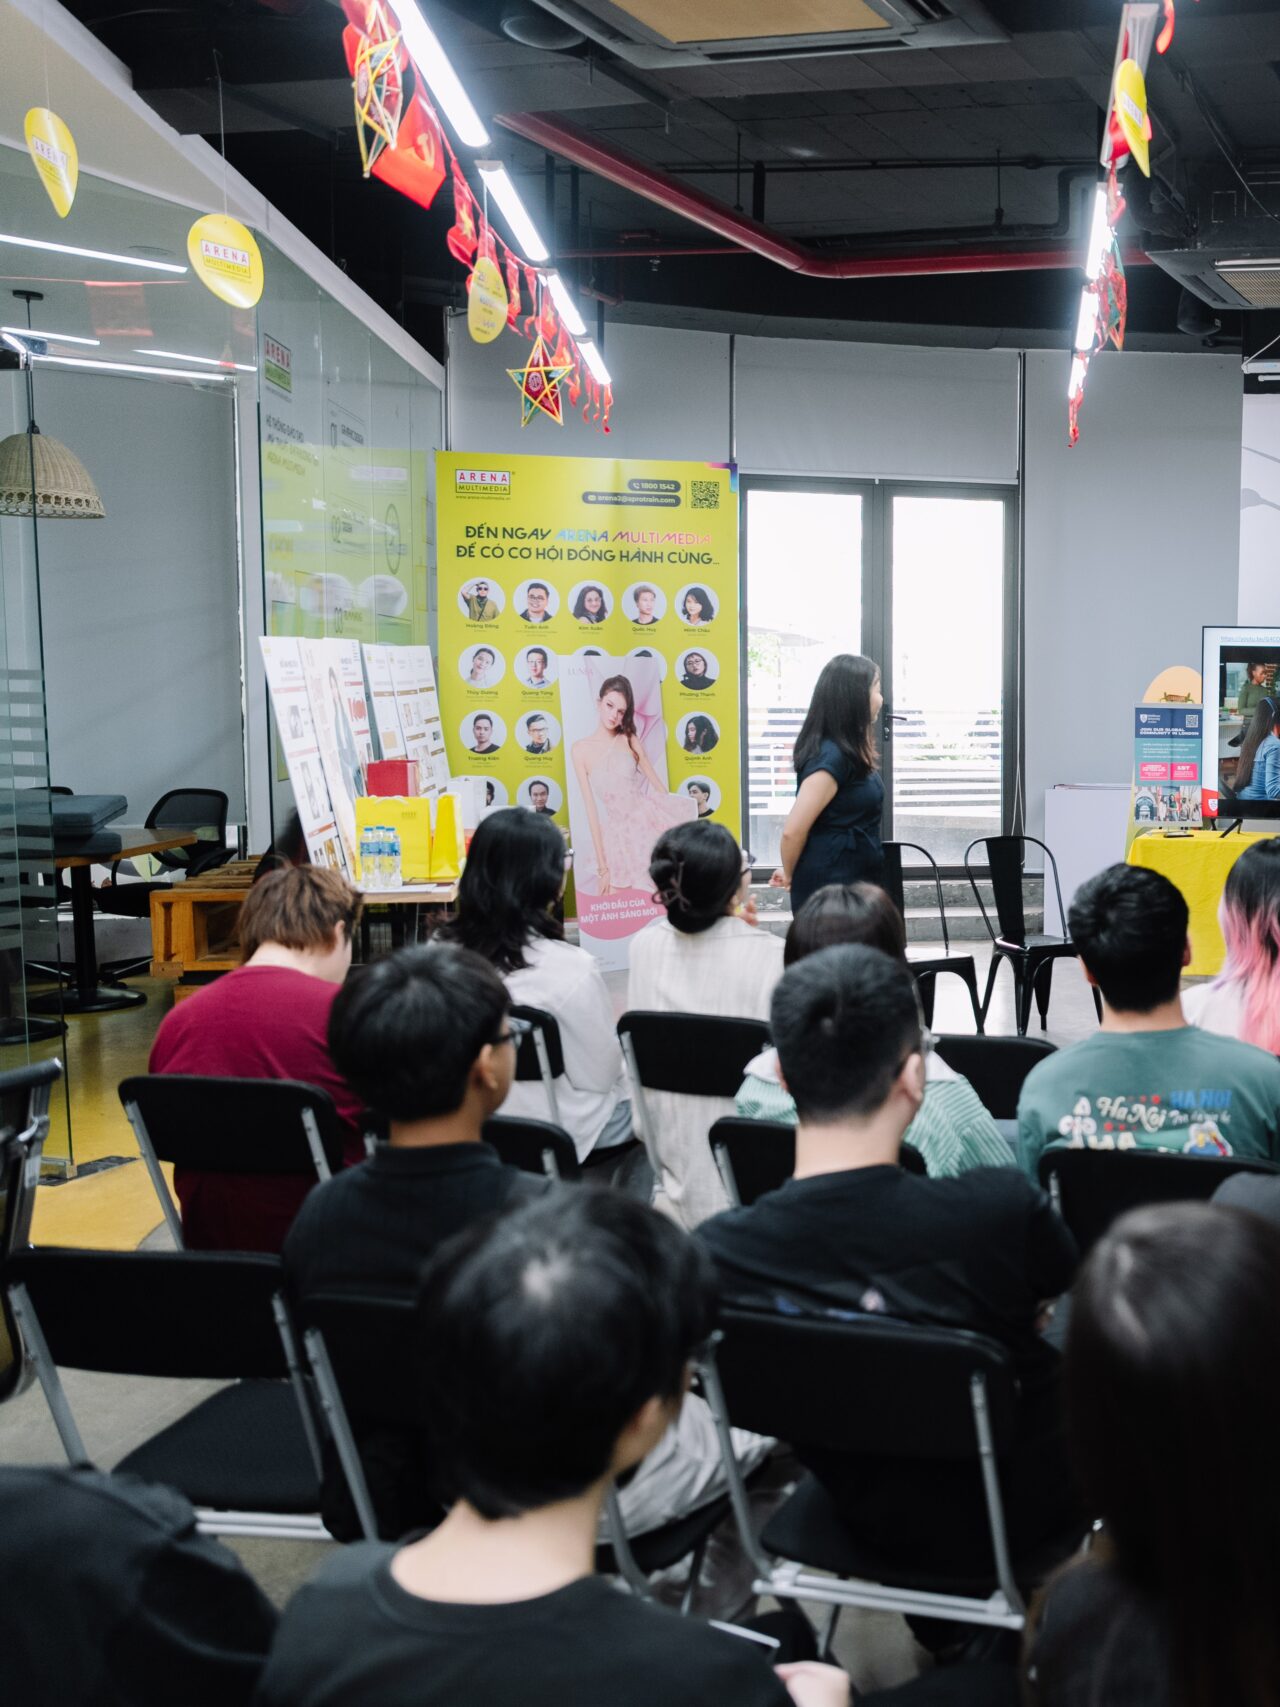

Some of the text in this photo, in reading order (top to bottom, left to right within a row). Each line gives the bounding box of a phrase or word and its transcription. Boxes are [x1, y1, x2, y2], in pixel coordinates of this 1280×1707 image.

[204, 243, 248, 265] ARENA
[459, 472, 509, 482] ARENA
[458, 484, 509, 493] MULTIMEDIA
[641, 482, 676, 491] 1800 1542
[465, 522, 713, 546] ĐẾN NGAY ARENA MULTIMEDIA
[480, 543, 505, 559] CÓ
[508, 546, 533, 560] CƠ
[536, 545, 563, 562] HỘI
[567, 545, 616, 562] ĐỒNG
[619, 547, 664, 564] HÀNH
